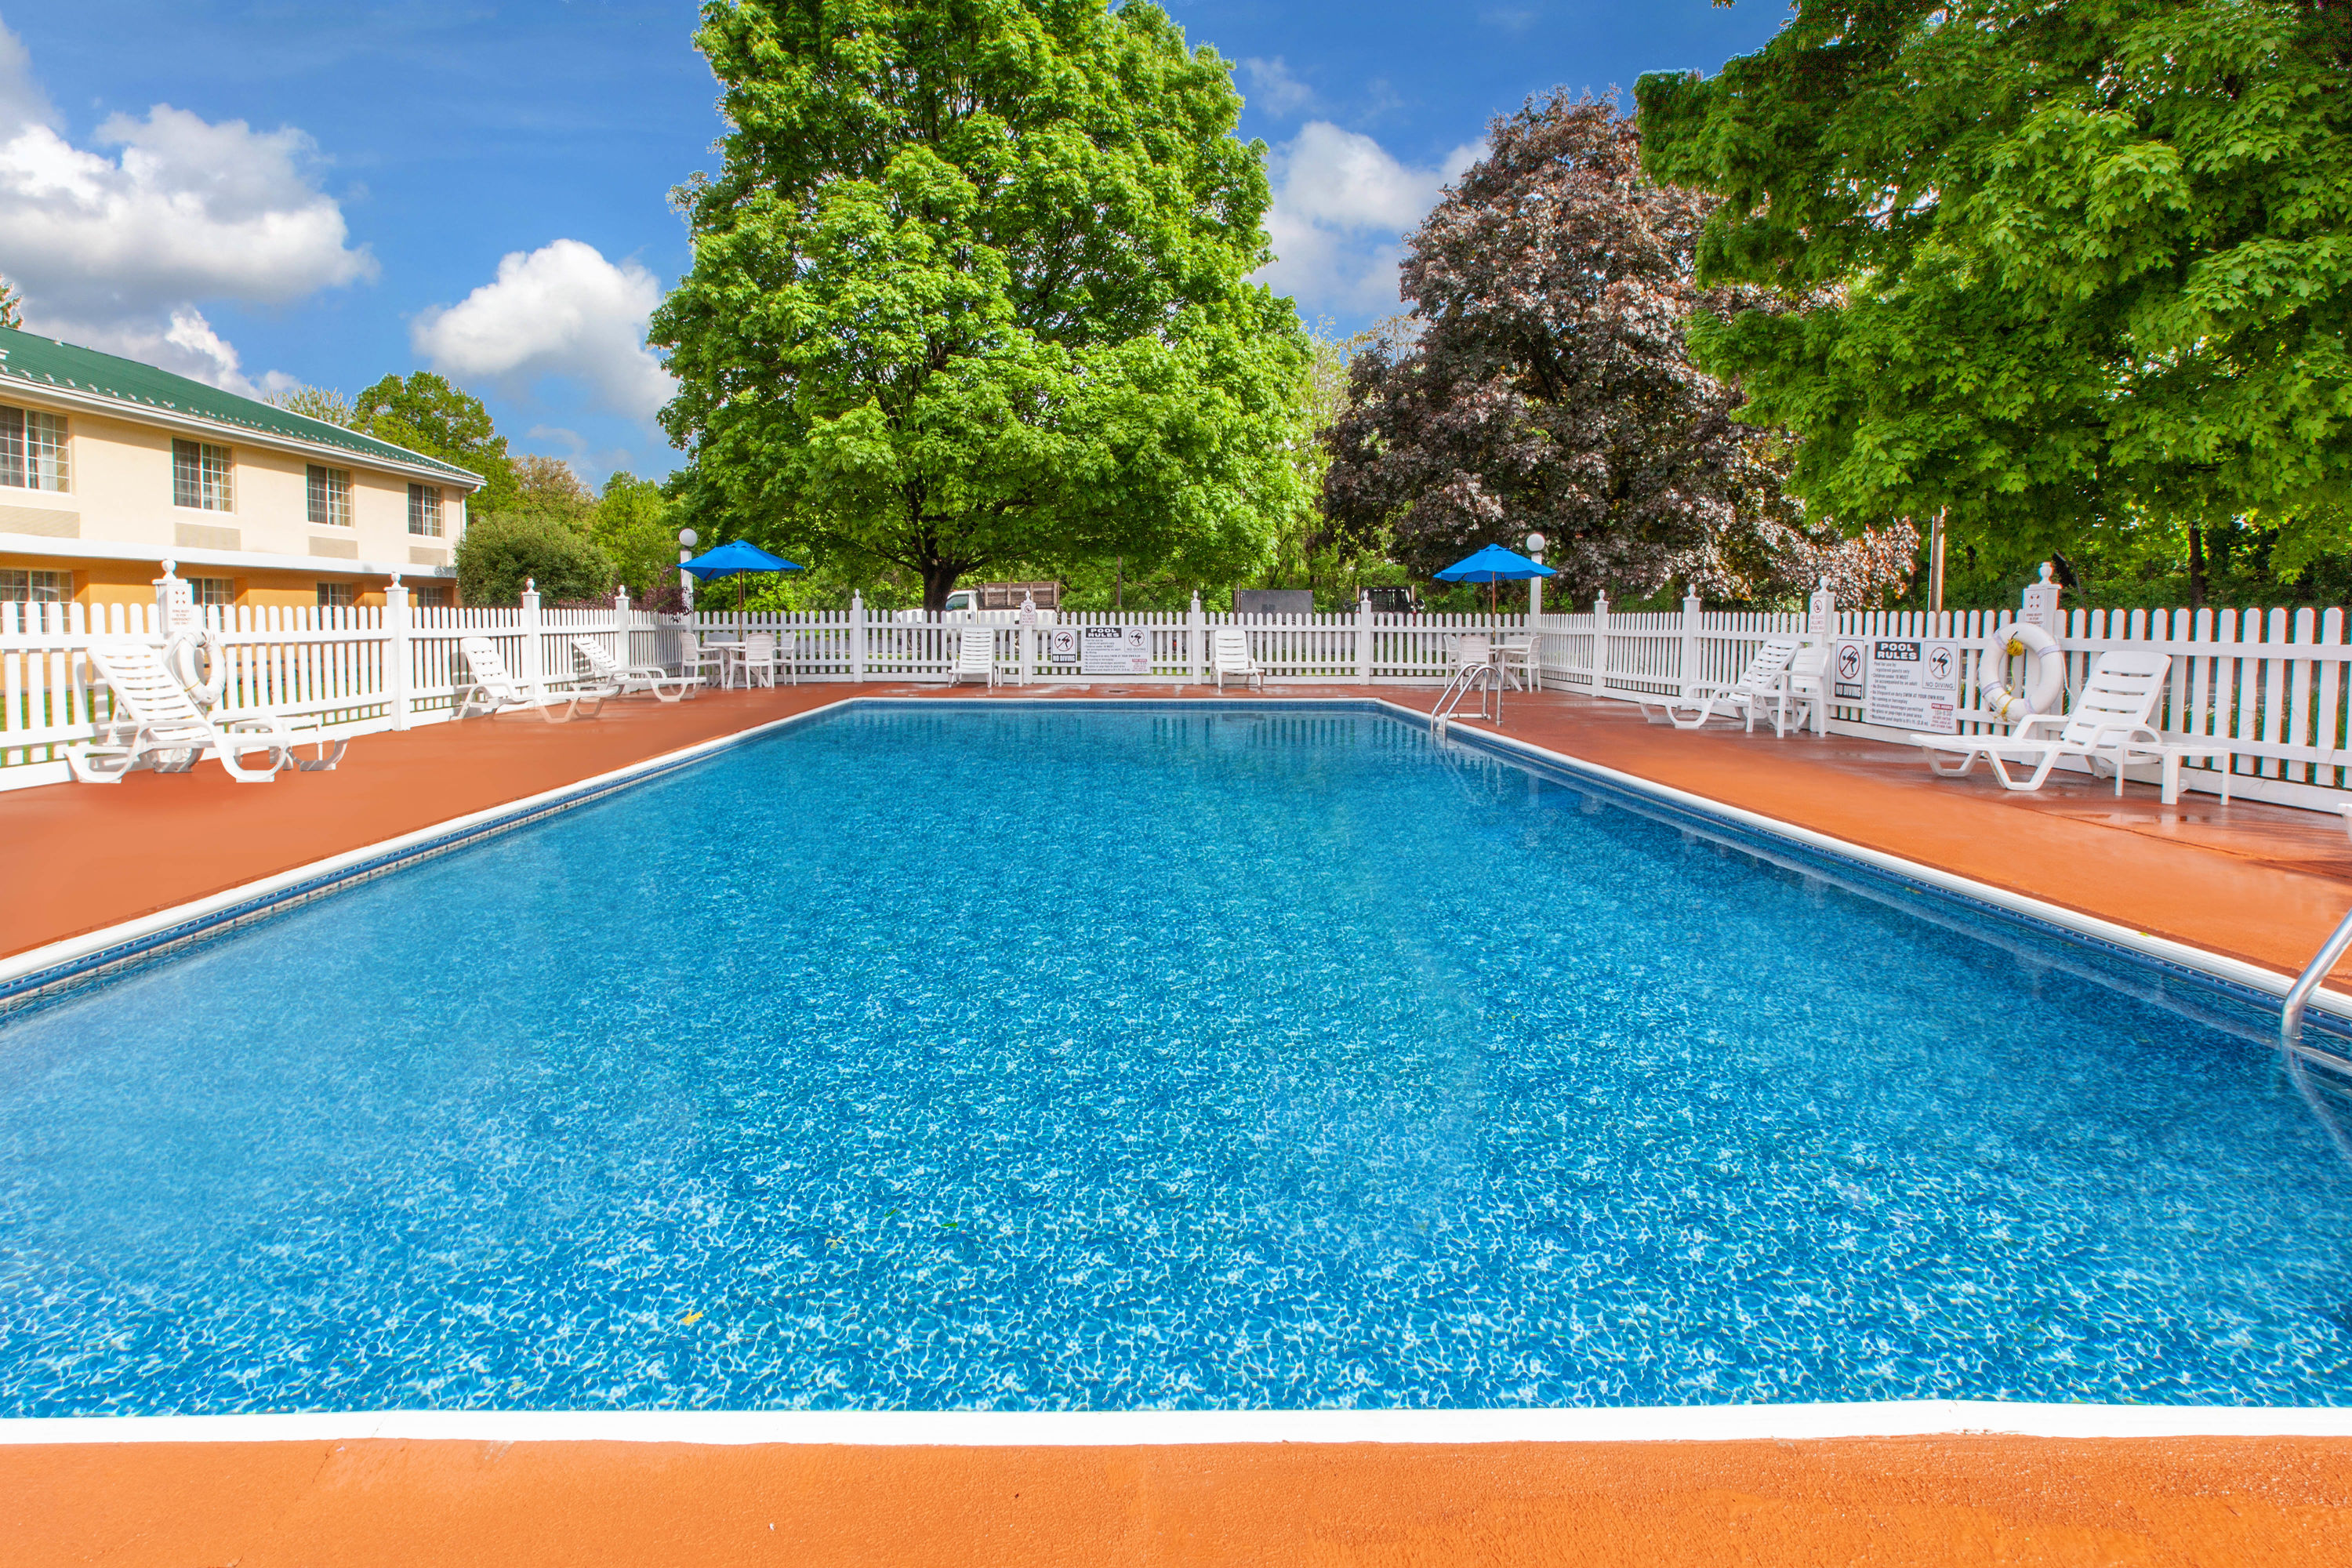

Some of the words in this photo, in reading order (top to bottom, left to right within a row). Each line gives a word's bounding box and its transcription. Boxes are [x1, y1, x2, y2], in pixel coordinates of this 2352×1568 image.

[1881, 643, 1914, 652] POOL
[1877, 652, 1918, 660] RULES
[1836, 684, 1842, 695] NO
[1843, 685, 1861, 697] DIVING
